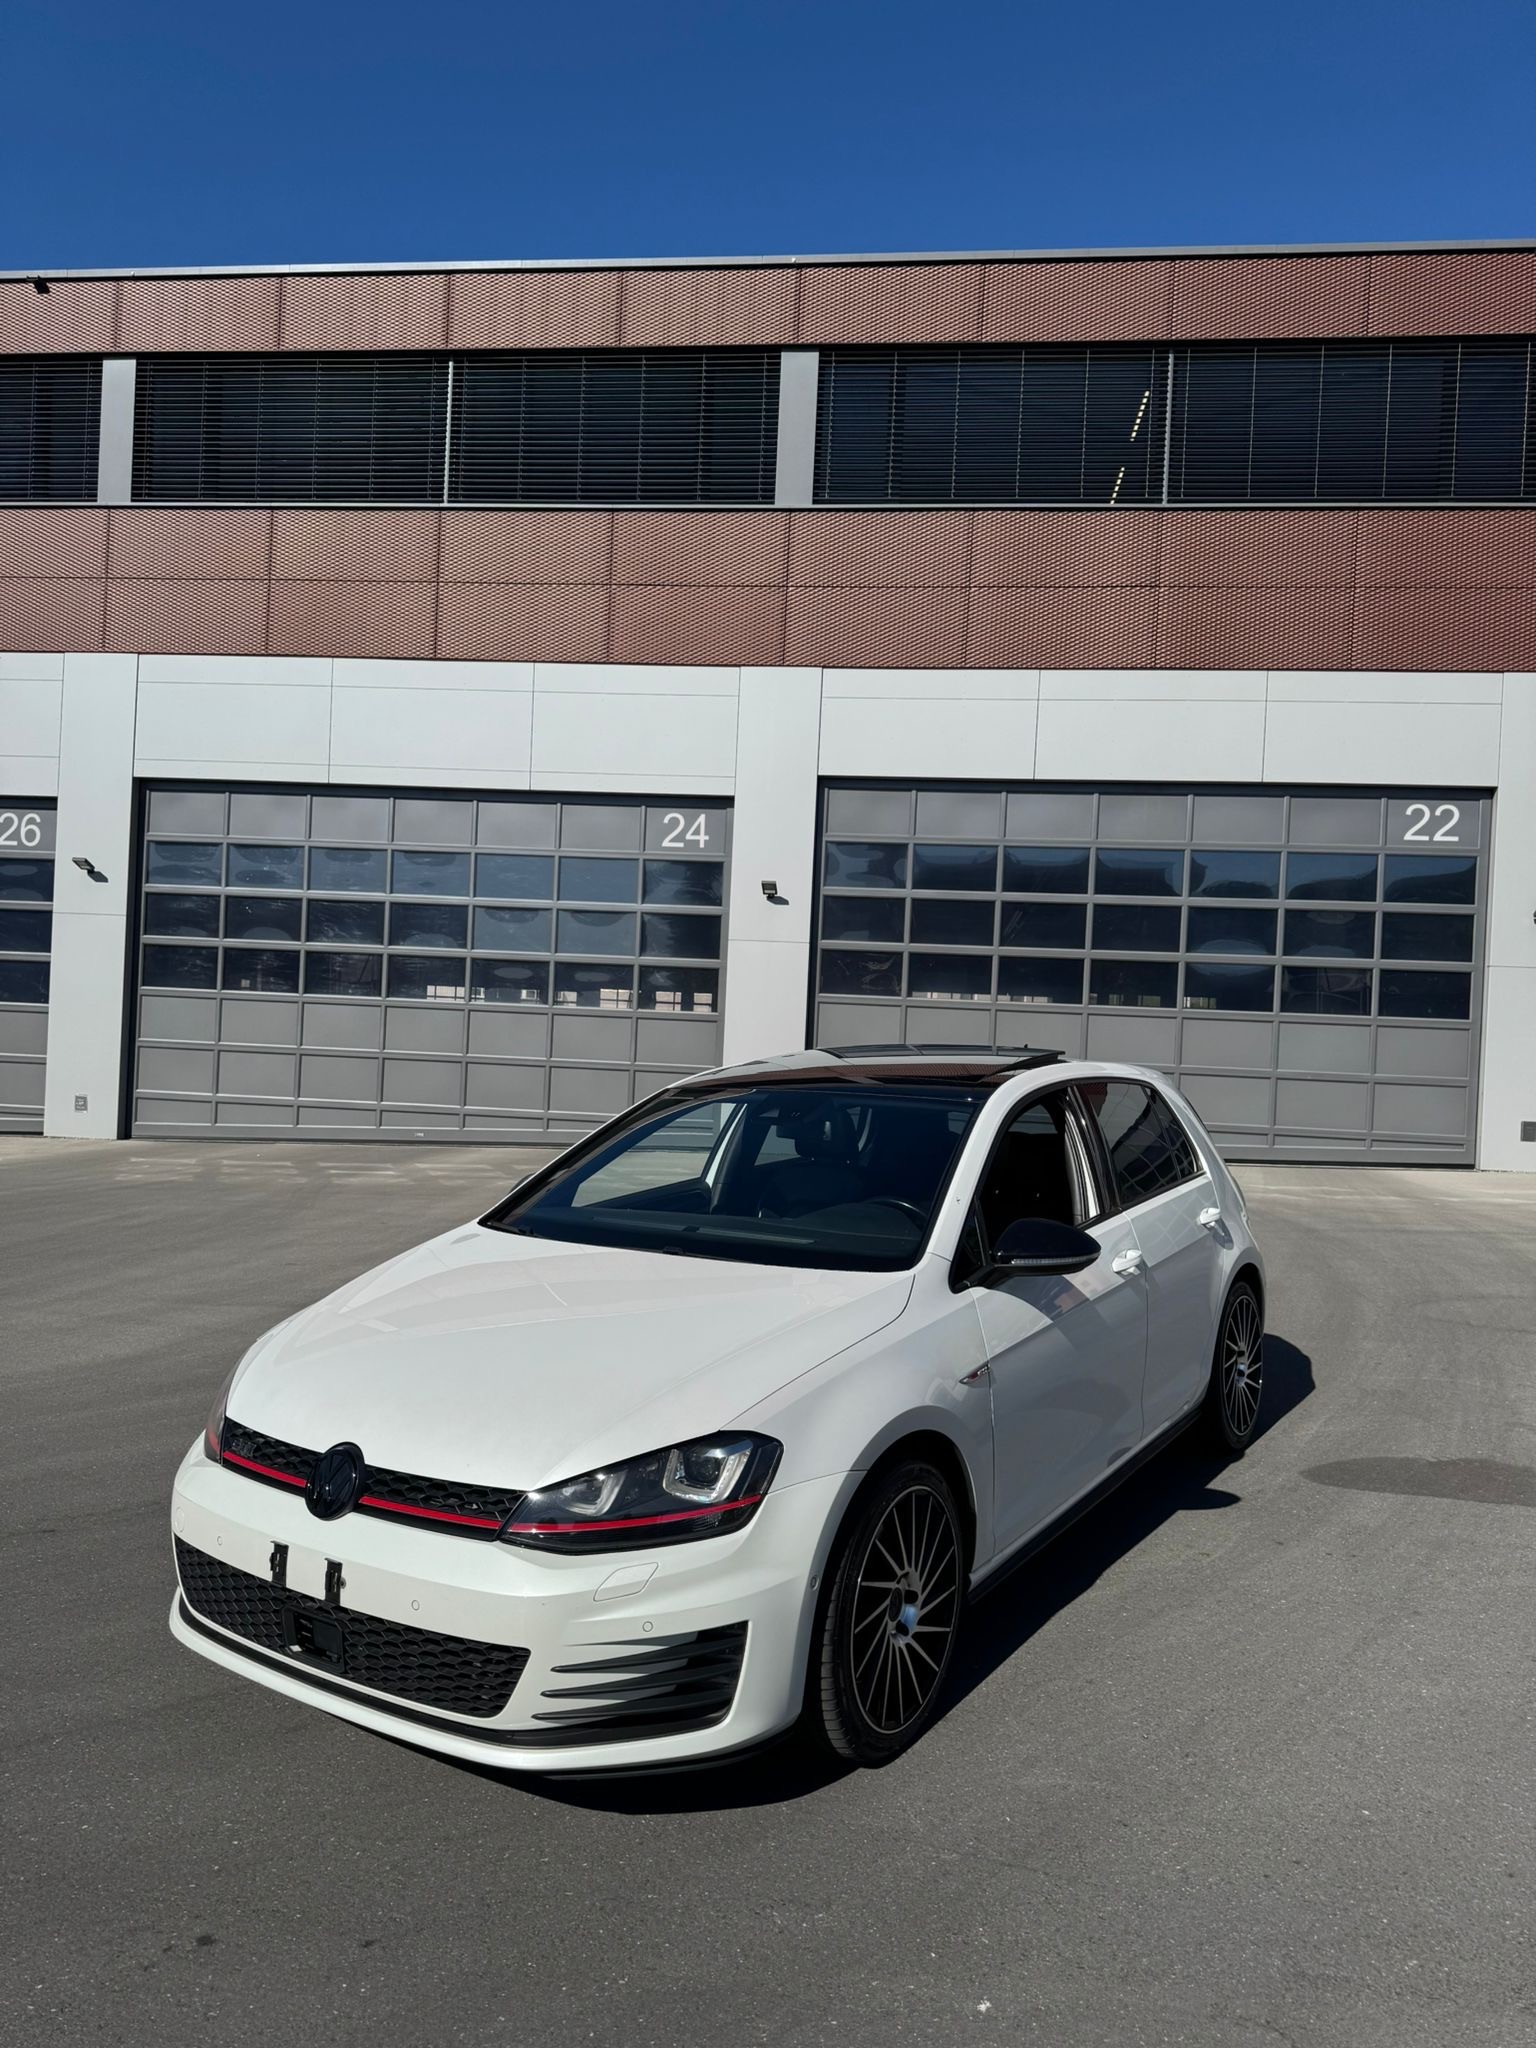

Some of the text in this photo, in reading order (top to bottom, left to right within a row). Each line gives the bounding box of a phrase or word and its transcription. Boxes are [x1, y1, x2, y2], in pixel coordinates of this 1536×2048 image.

[0, 812, 41, 847] 26
[661, 812, 710, 848] 24
[1403, 803, 1460, 842] 22
